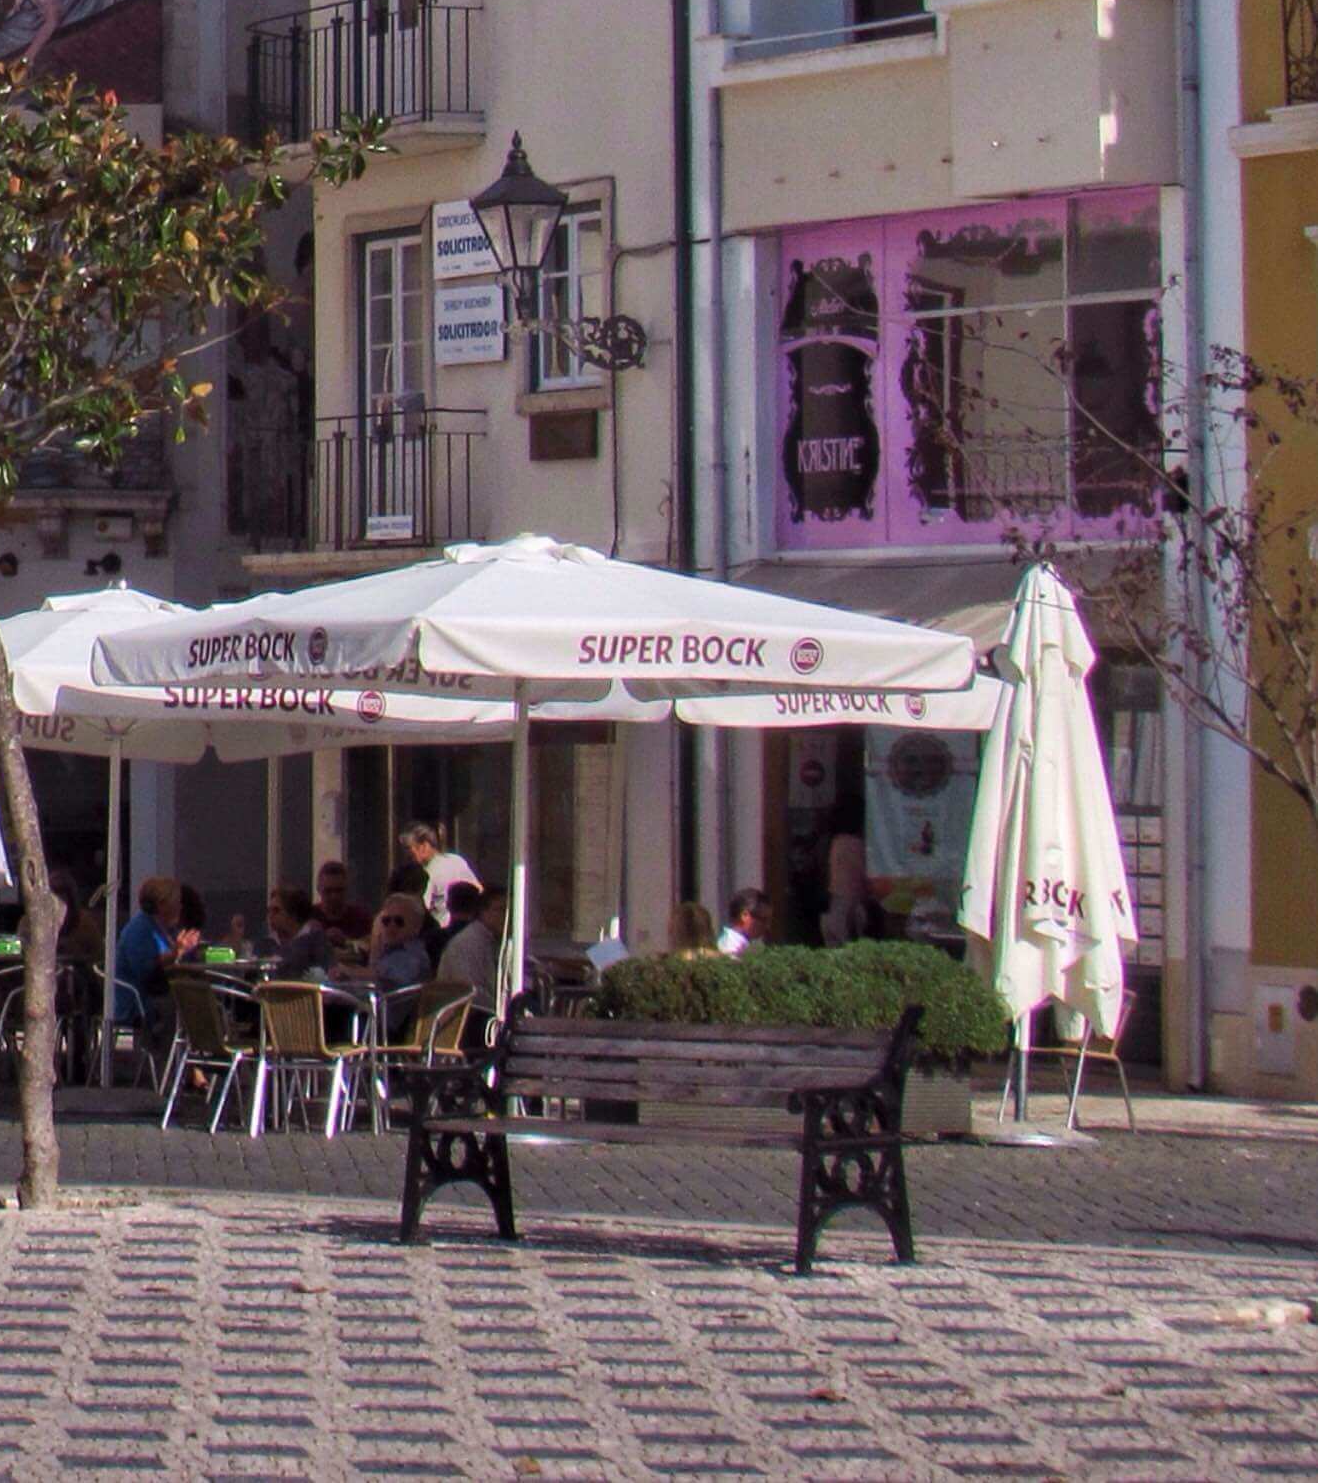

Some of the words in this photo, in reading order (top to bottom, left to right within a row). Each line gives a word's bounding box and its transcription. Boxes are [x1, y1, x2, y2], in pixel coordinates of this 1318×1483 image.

[437, 235, 491, 257] SOLICITADO
[437, 320, 498, 342] SOLICITADOR
[188, 635, 241, 667] SUPER
[244, 631, 296, 662] BOCK
[578, 635, 673, 664] SUPER
[682, 636, 766, 666] BOCK
[164, 686, 253, 710] SUPER
[259, 687, 336, 715] BOCK
[775, 693, 832, 715] SUPER
